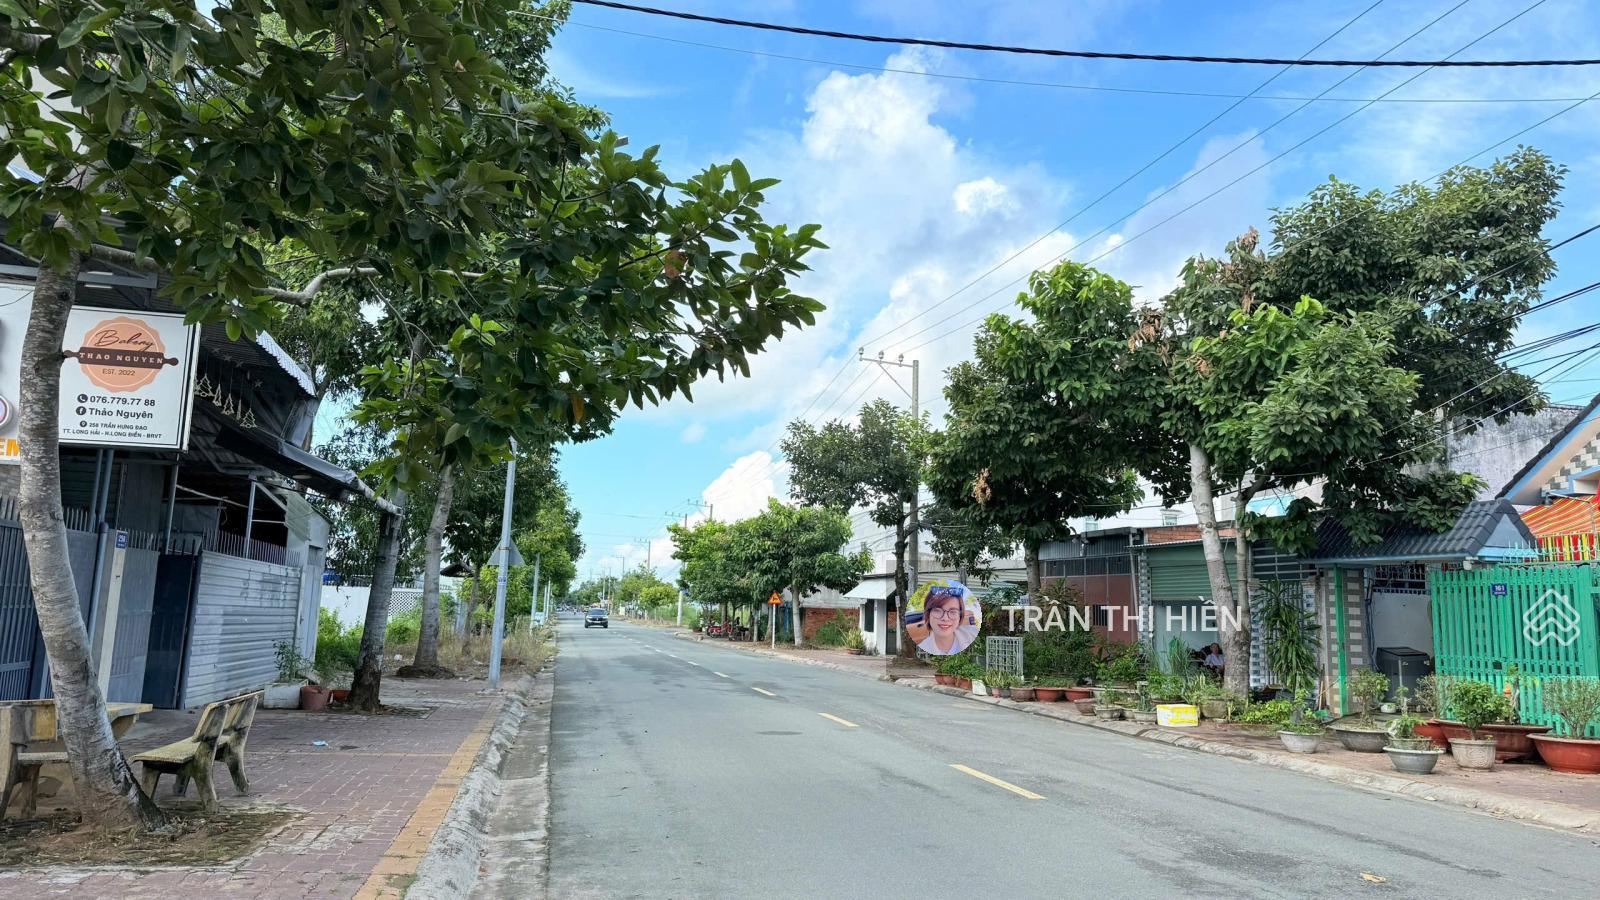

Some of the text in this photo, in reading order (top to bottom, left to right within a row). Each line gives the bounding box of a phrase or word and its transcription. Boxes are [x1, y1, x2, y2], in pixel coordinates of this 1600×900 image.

[116, 354, 163, 364] NGUYEN
[89, 395, 141, 406] 076.779.77
[88, 407, 153, 419] Thảo Nguyên
